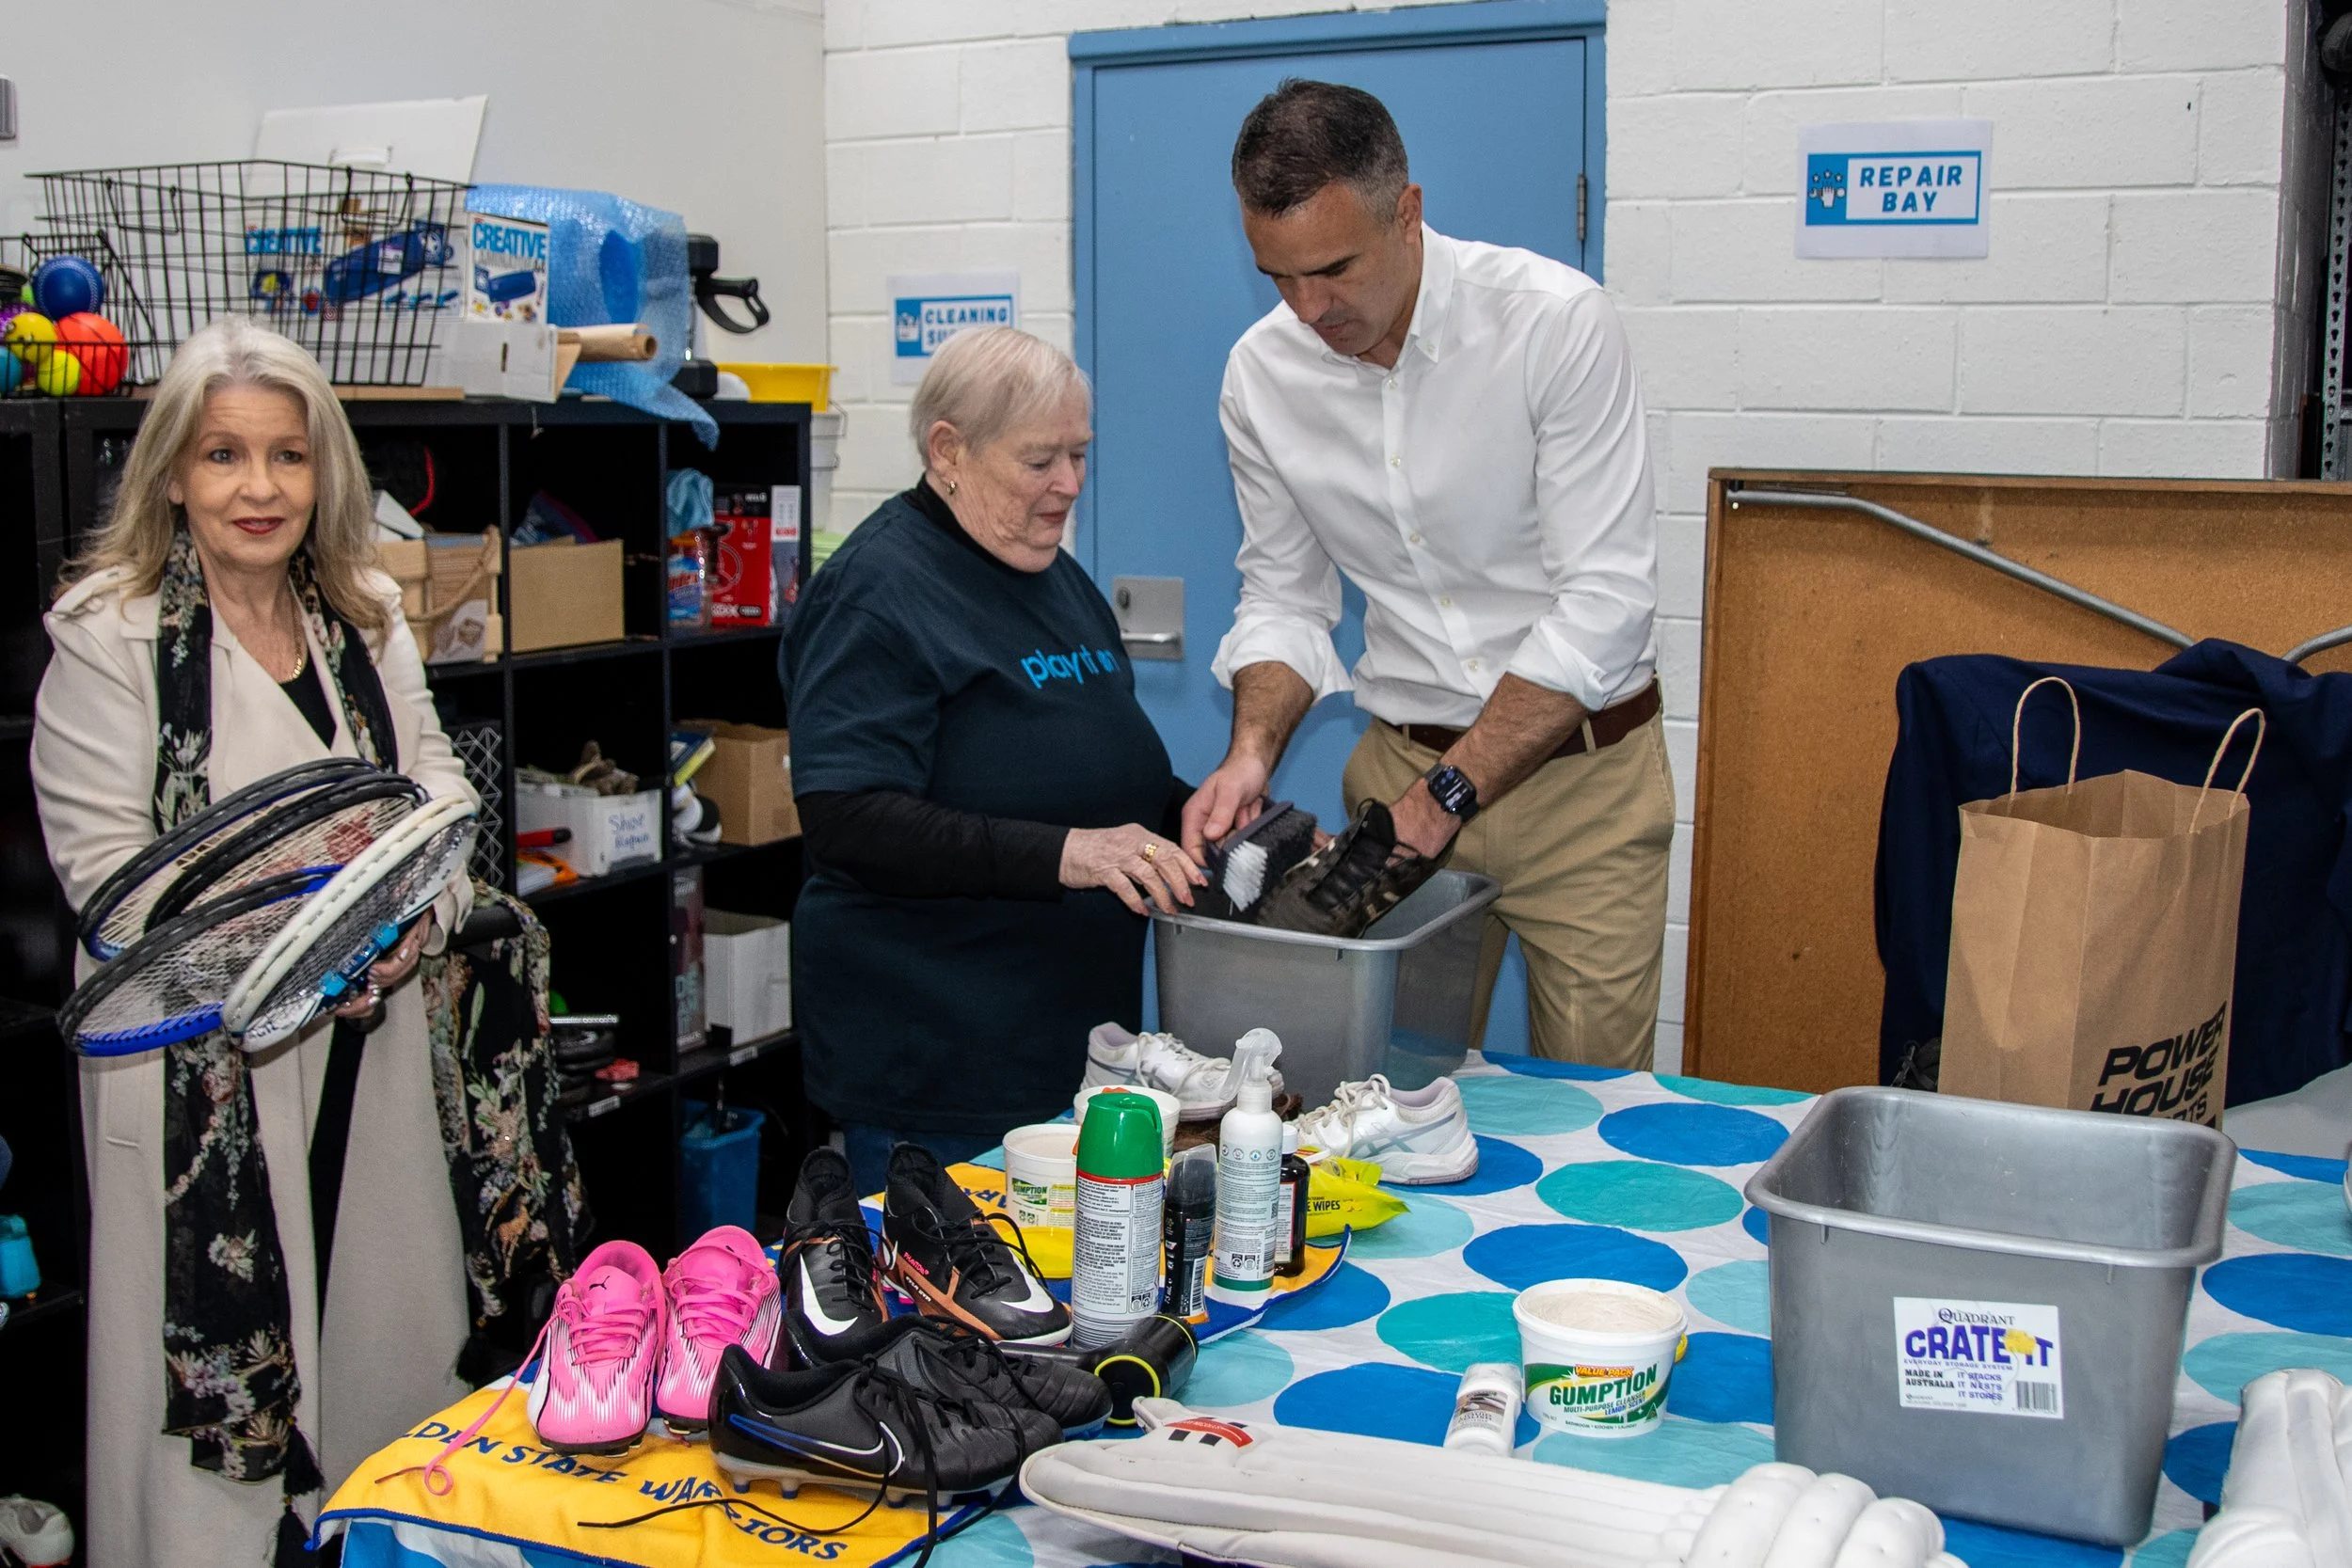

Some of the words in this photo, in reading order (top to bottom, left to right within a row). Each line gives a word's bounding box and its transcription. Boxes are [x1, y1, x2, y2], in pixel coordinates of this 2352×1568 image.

[1859, 165, 1963, 187] REPAIR
[1882, 191, 1938, 213] BAY
[473, 223, 547, 260] CREATIVE
[925, 308, 1008, 325] CLEANING
[2097, 1000, 2227, 1087] POWER
[2089, 1042, 2220, 1116] HOUSE
[1313, 1200, 1341, 1212] WIPES
[1937, 1307, 2016, 1325] QUADRANT
[1905, 1324, 2011, 1365] CRATE
[1903, 1357, 1942, 1366] EVERYDAY
[1575, 1365, 1606, 1376] VALUE
[1607, 1367, 1633, 1377] PACK
[1904, 1369, 1931, 1378] MADE
[1932, 1370, 1944, 1378] IN
[1967, 1372, 2002, 1381] STACKS
[1549, 1364, 1658, 1406] GUMPTION
[1904, 1378, 1955, 1388] AUSTRALIA
[1970, 1381, 2003, 1391] NESTS
[1563, 1402, 1614, 1414] MULTI-PURPOSE
[1615, 1390, 1645, 1407] CLEANSER
[1968, 1391, 2003, 1402] STORES
[1604, 1403, 1627, 1416] LEMON
[1628, 1397, 1645, 1409] SCENT
[501, 1446, 629, 1484] STATE
[639, 1476, 850, 1560] WARRIORS
